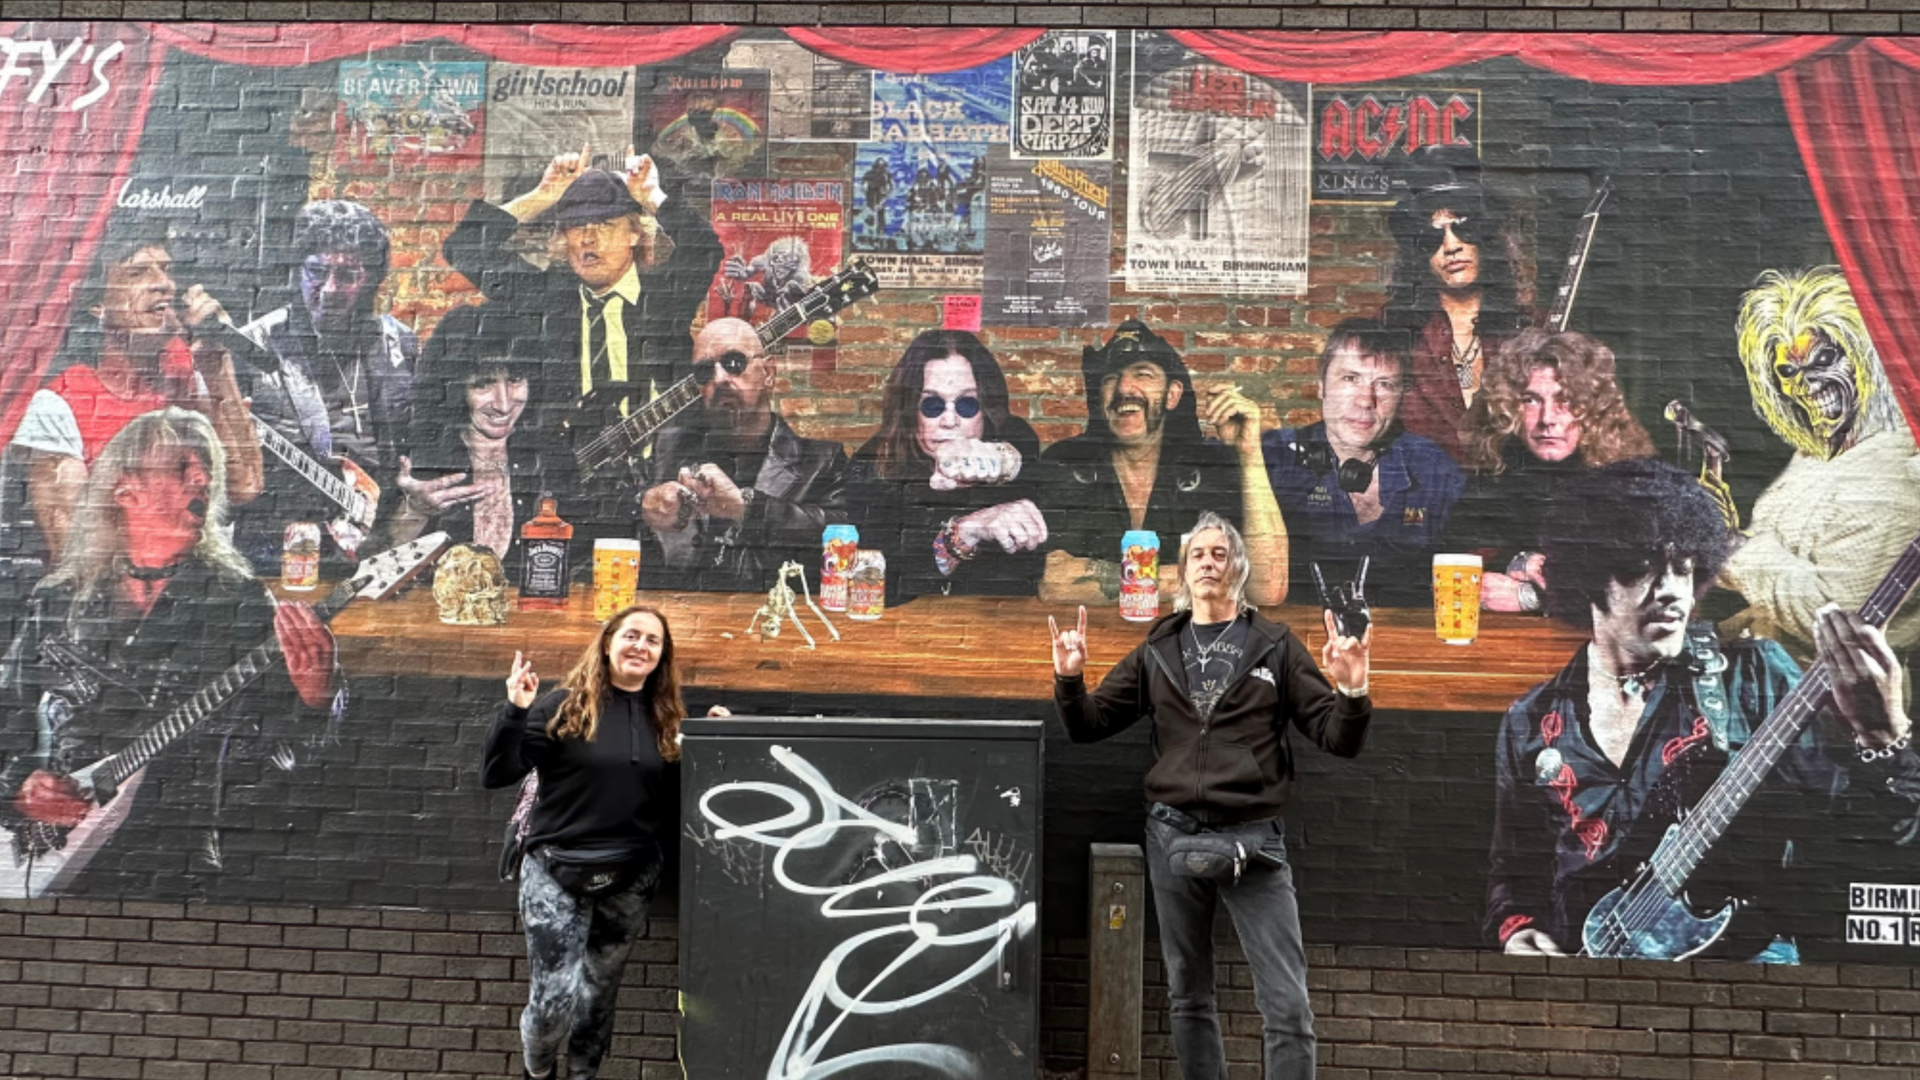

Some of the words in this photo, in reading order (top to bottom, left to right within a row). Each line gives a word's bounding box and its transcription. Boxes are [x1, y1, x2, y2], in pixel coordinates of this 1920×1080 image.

[0, 36, 125, 111] FY'S
[492, 69, 629, 102] girlschool
[1021, 96, 1057, 114] SAT
[1059, 96, 1079, 114] 14
[1020, 114, 1101, 134] DEEP
[714, 182, 762, 204] IRON
[765, 182, 842, 204] MAIDEN
[1318, 174, 1389, 192] KING'S
[715, 212, 726, 222] A
[731, 212, 770, 222] REAL
[807, 212, 840, 222] ONE
[1072, 196, 1105, 220] TOUR
[1129, 259, 1170, 270] TOWN
[1175, 260, 1208, 271] HALL
[1223, 261, 1307, 272] BIRMINGHAM
[1851, 886, 1920, 910] BIRMI
[1847, 919, 1900, 942] NO.1
